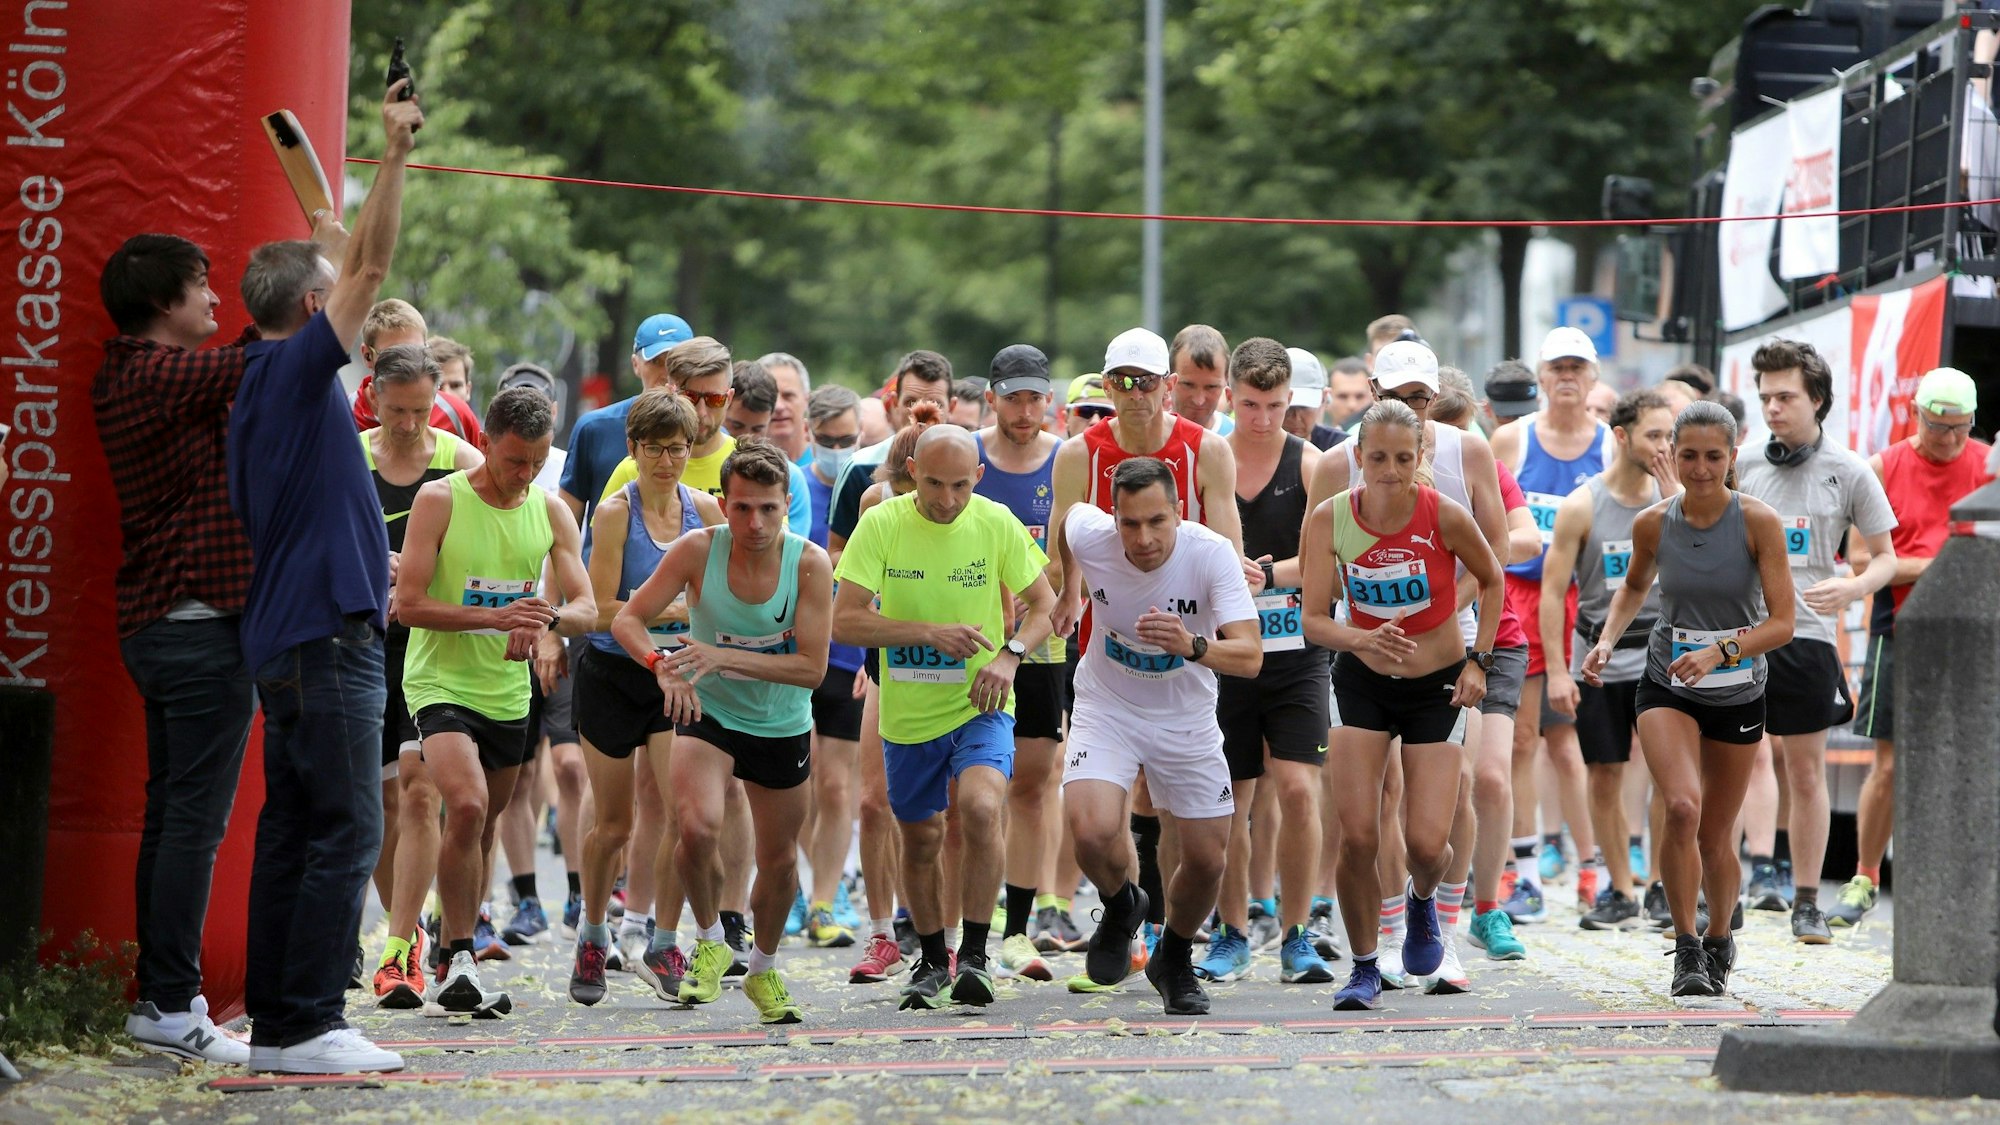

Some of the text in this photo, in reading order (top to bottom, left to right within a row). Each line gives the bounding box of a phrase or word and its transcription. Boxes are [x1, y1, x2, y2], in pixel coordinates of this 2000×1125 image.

[0, 1, 71, 688] Kreissparkasse Köln
[947, 573, 987, 582] TRIATHLON
[962, 580, 987, 588] HAGEN
[1354, 578, 1425, 604] 3110
[893, 645, 960, 666] 303
[1110, 641, 1176, 671] 3017
[912, 670, 941, 681] Jimmy
[1125, 667, 1163, 679] Michael
